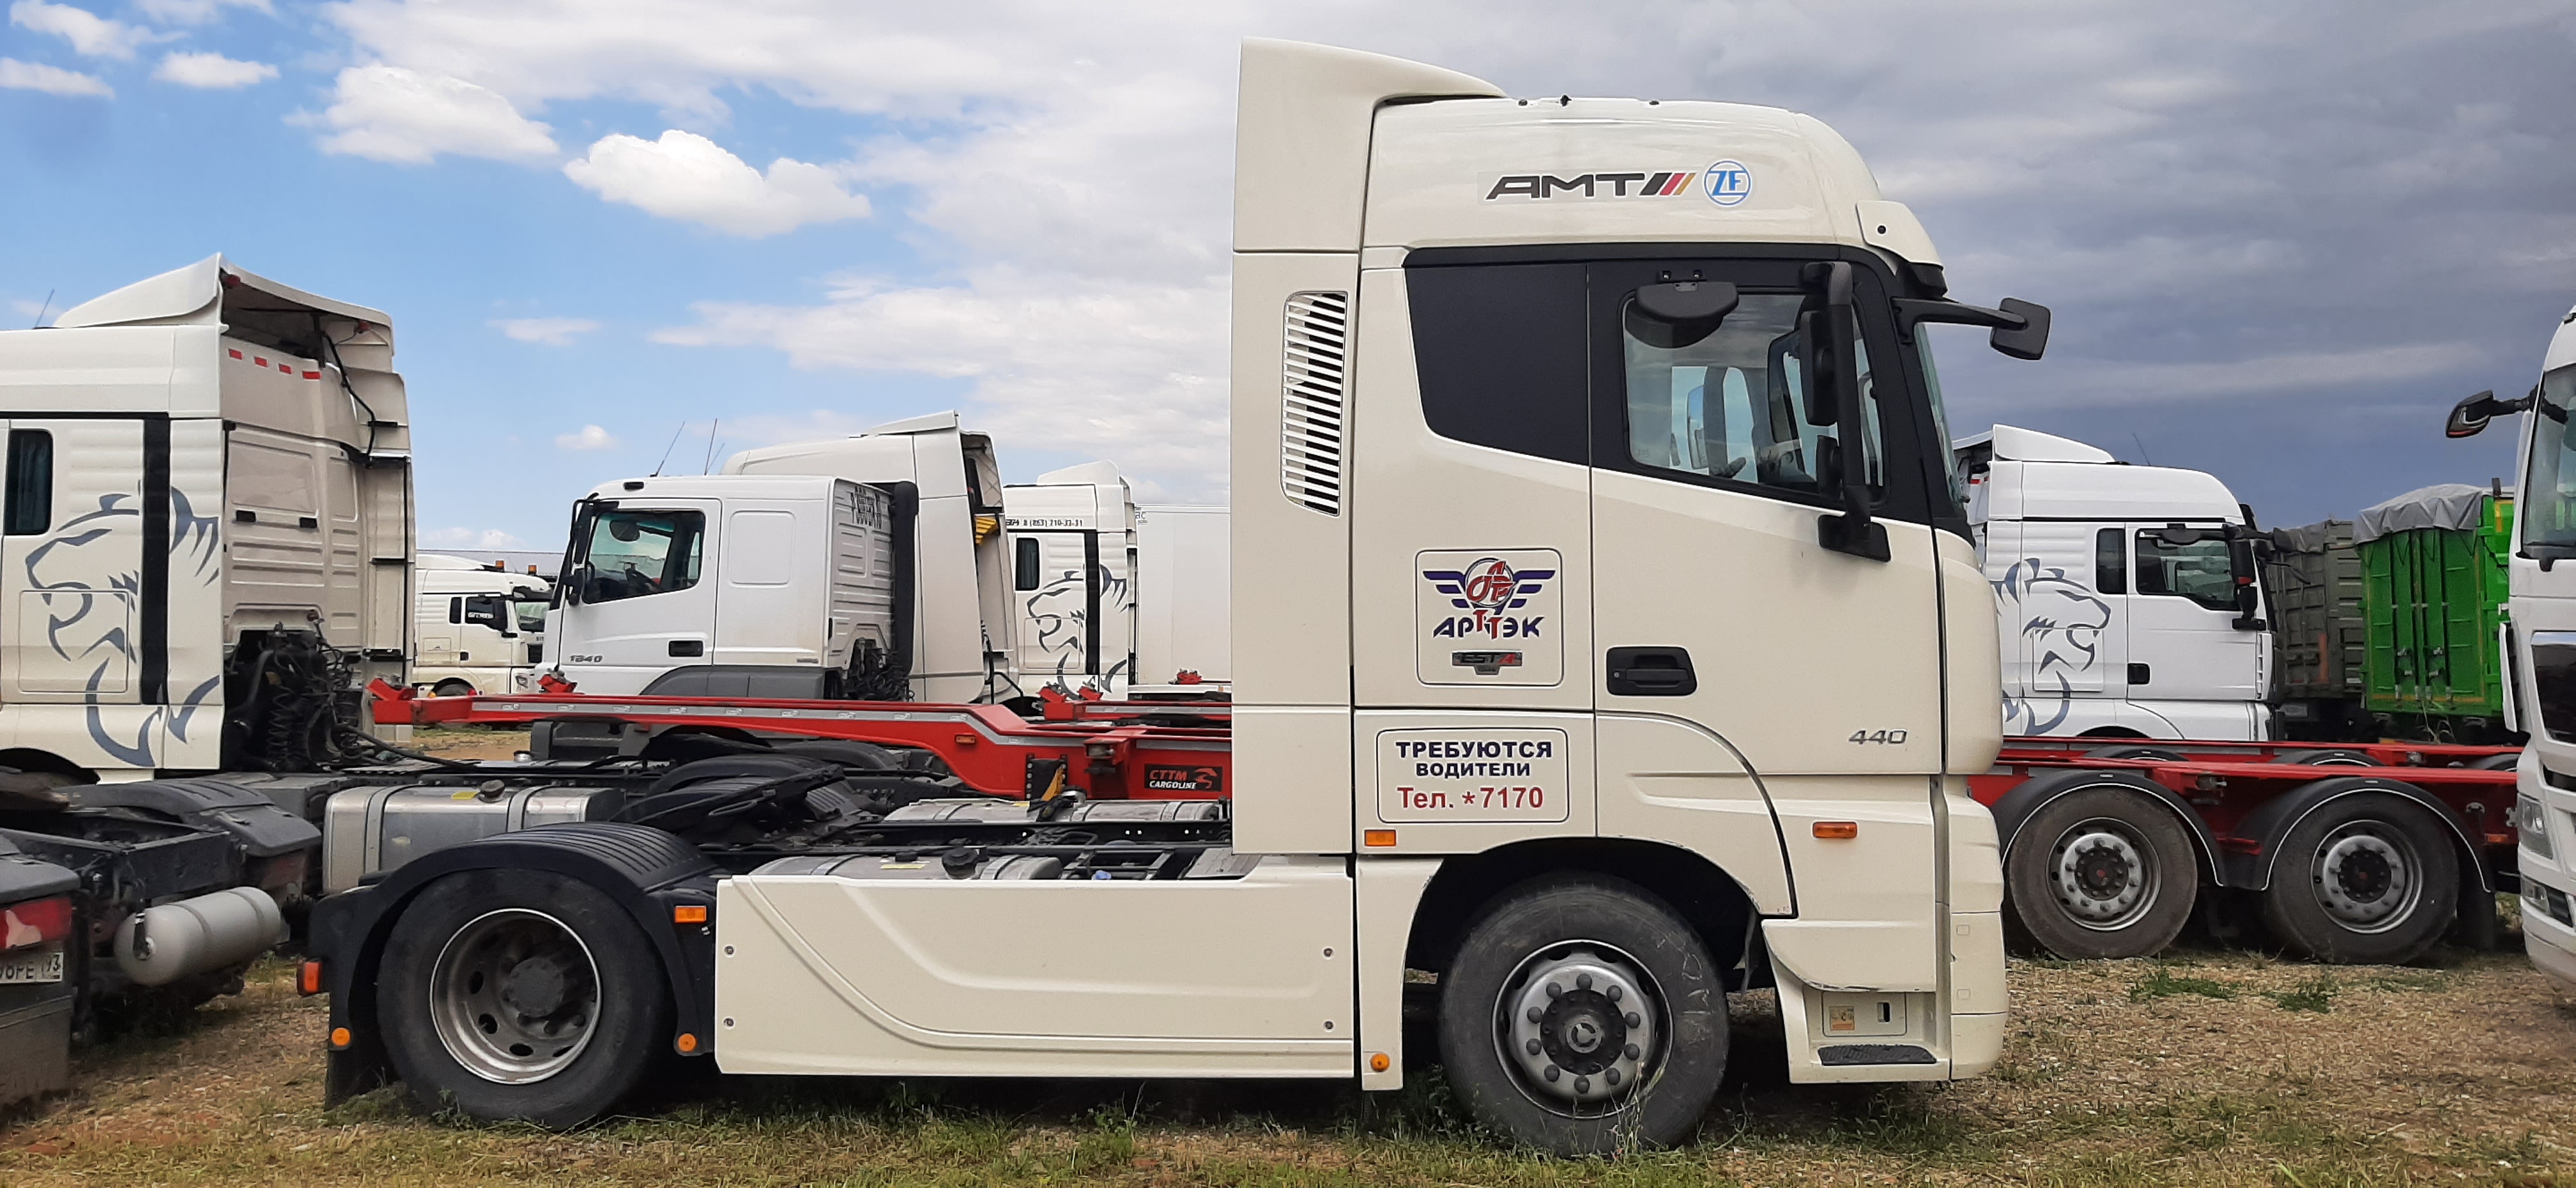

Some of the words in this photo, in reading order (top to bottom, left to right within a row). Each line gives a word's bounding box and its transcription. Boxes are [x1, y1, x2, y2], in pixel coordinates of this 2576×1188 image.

[1485, 172, 1645, 200] AMT
[1706, 169, 1751, 198] ZF
[1848, 729, 1907, 744] 440
[1395, 741, 1552, 758] ТРЕБУЮТСЯ
[1149, 770, 1187, 781] CTTM
[1416, 762, 1530, 779] ВОДИТЕЛИ
[1397, 787, 1453, 808] Тел.
